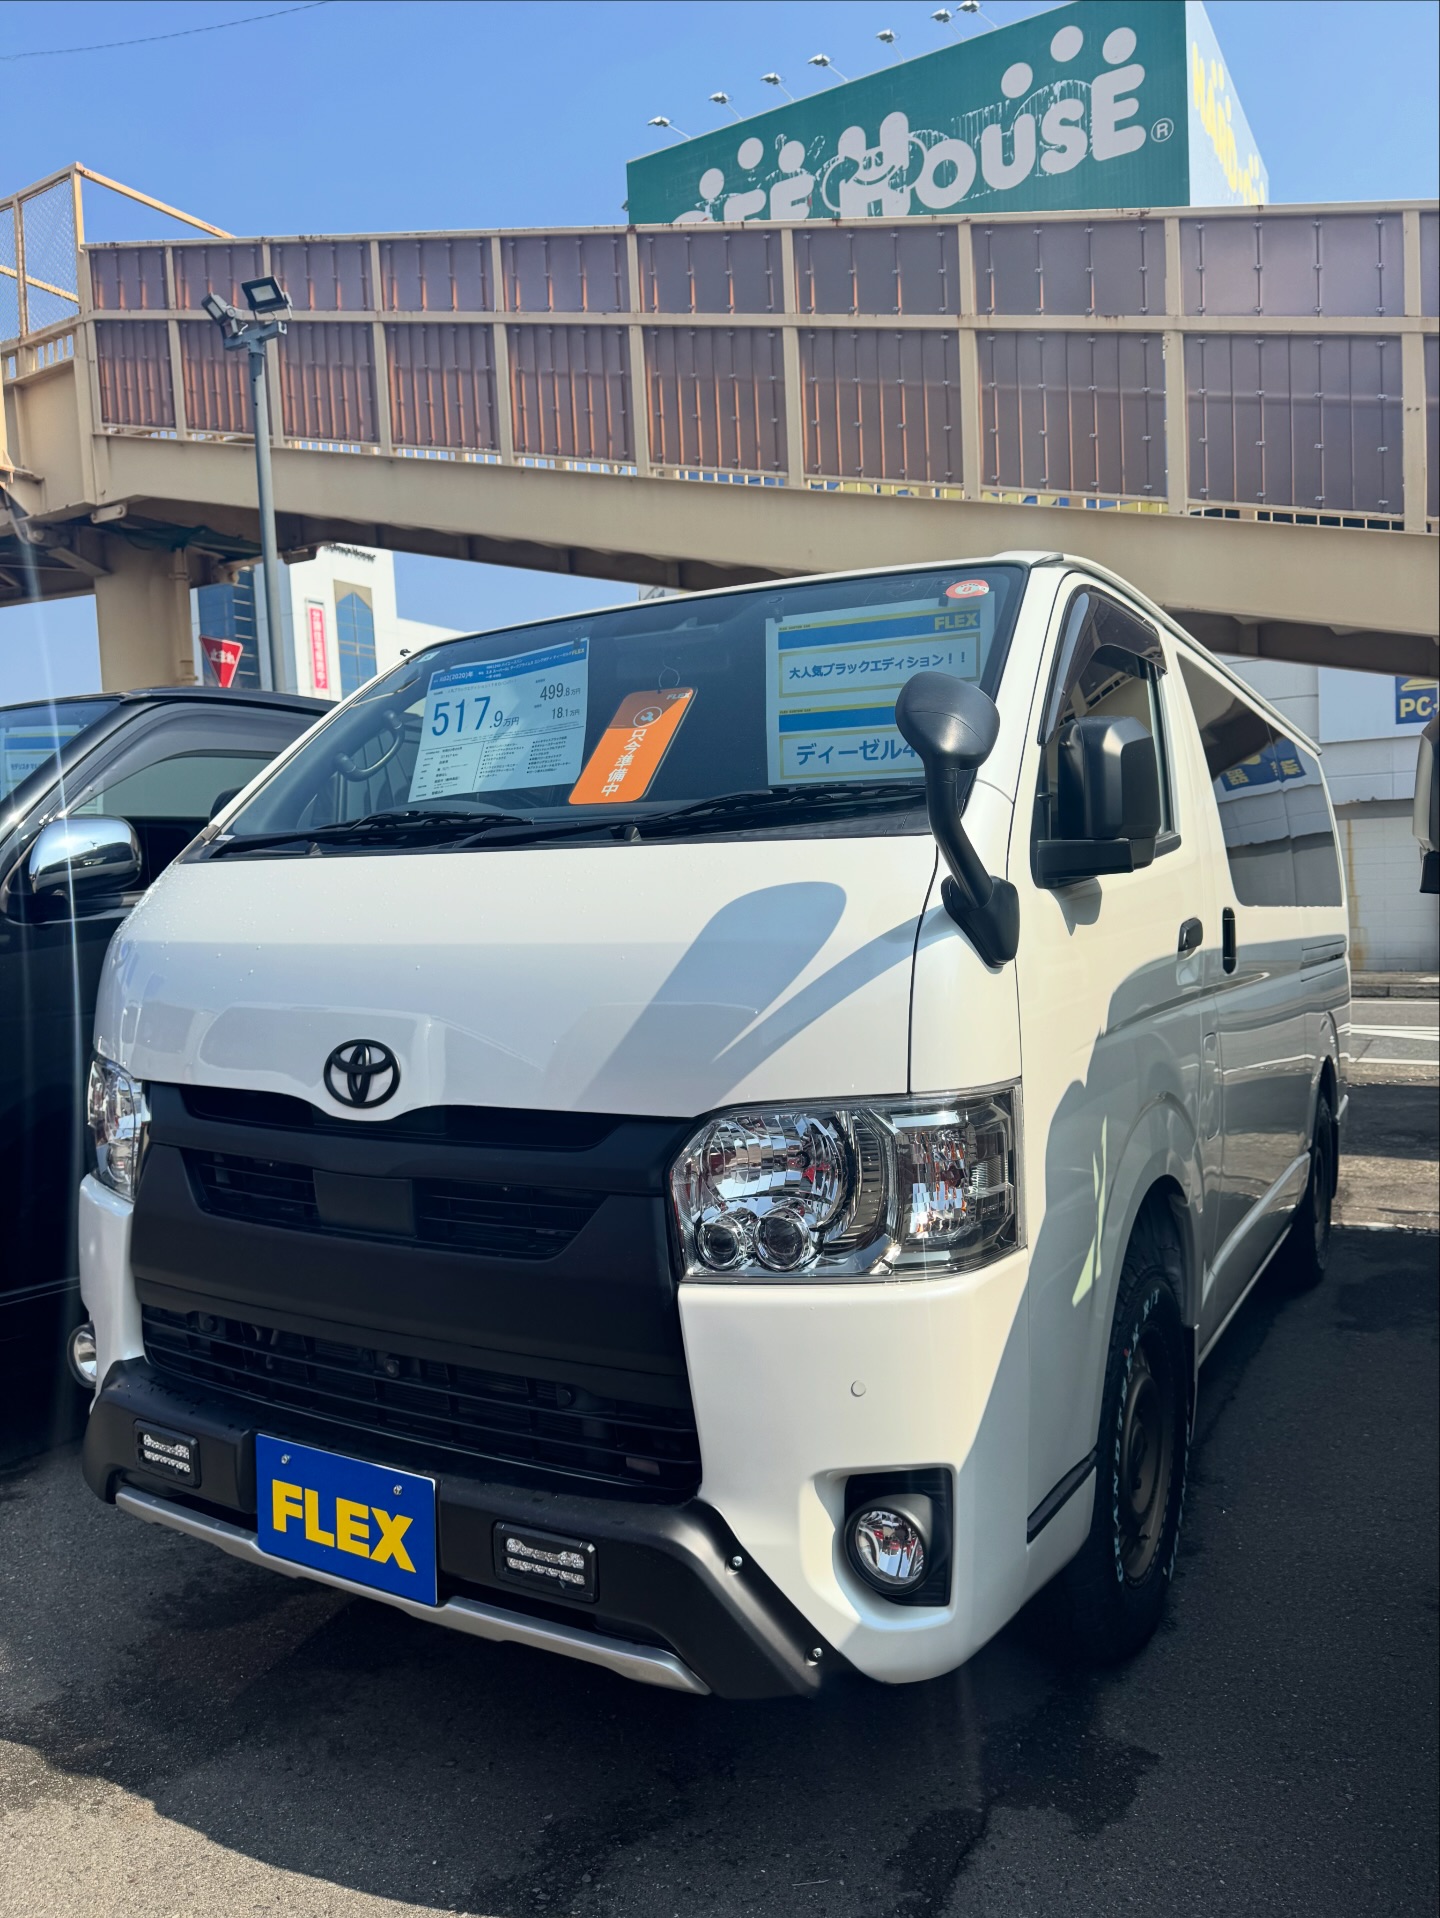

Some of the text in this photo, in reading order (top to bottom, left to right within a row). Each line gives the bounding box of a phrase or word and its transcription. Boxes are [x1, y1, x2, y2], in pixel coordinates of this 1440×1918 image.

[838, 63, 1146, 218] HOUSE
[934, 612, 979, 631] FLEX
[789, 651, 966, 680] 大人気ブラックエディション！！
[540, 683, 581, 702] 499.8万円
[666, 692, 691, 700] FLEX
[431, 695, 520, 737] 517.9万円
[550, 707, 581, 720] 18.1万円
[600, 728, 648, 797] 只今準備中
[271, 1478, 417, 1574] FLEX
